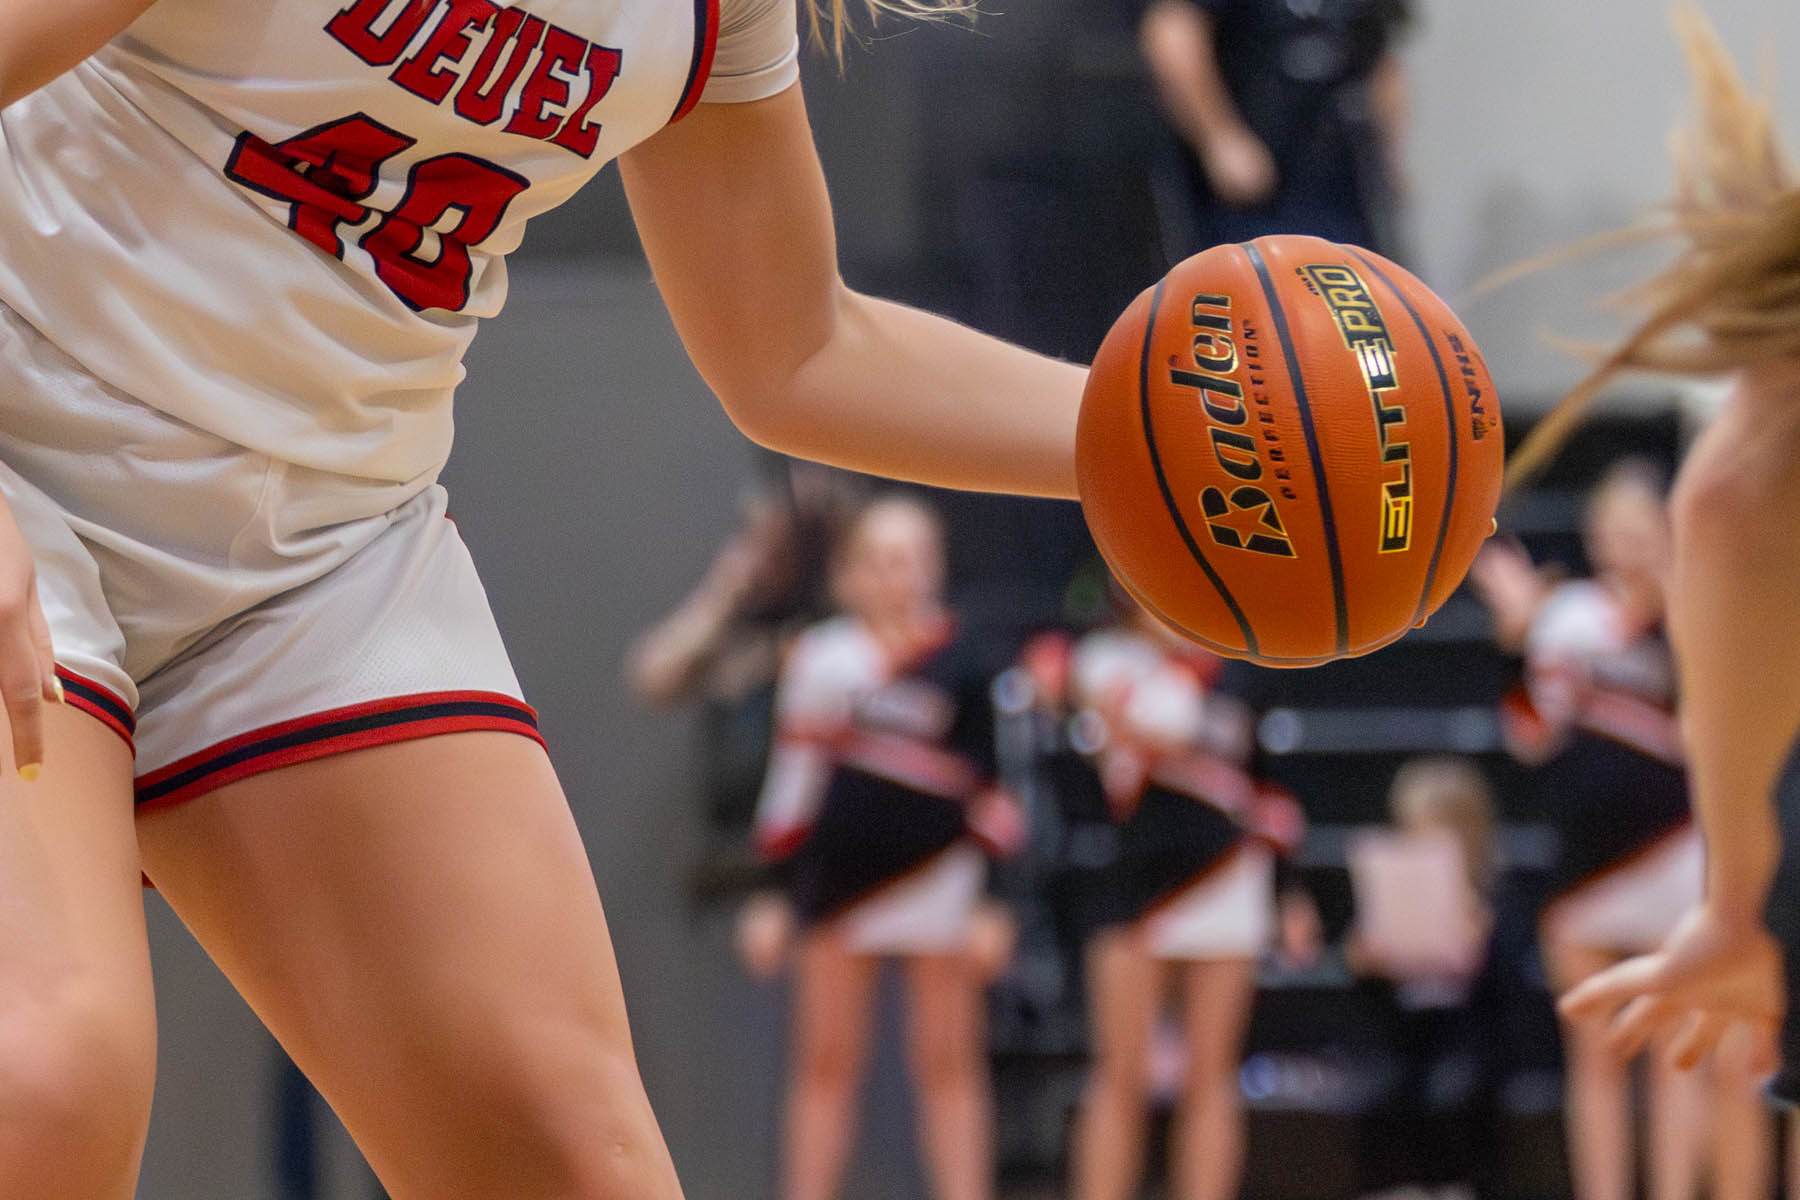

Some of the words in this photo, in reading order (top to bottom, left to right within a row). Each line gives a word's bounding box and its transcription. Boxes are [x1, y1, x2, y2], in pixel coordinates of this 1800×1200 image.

[224, 111, 530, 312] 40
[1312, 266, 1384, 335] PRO
[1169, 293, 1297, 558] Baden
[1243, 326, 1297, 500] PERFECTION
[1353, 339, 1414, 554] ELITE
